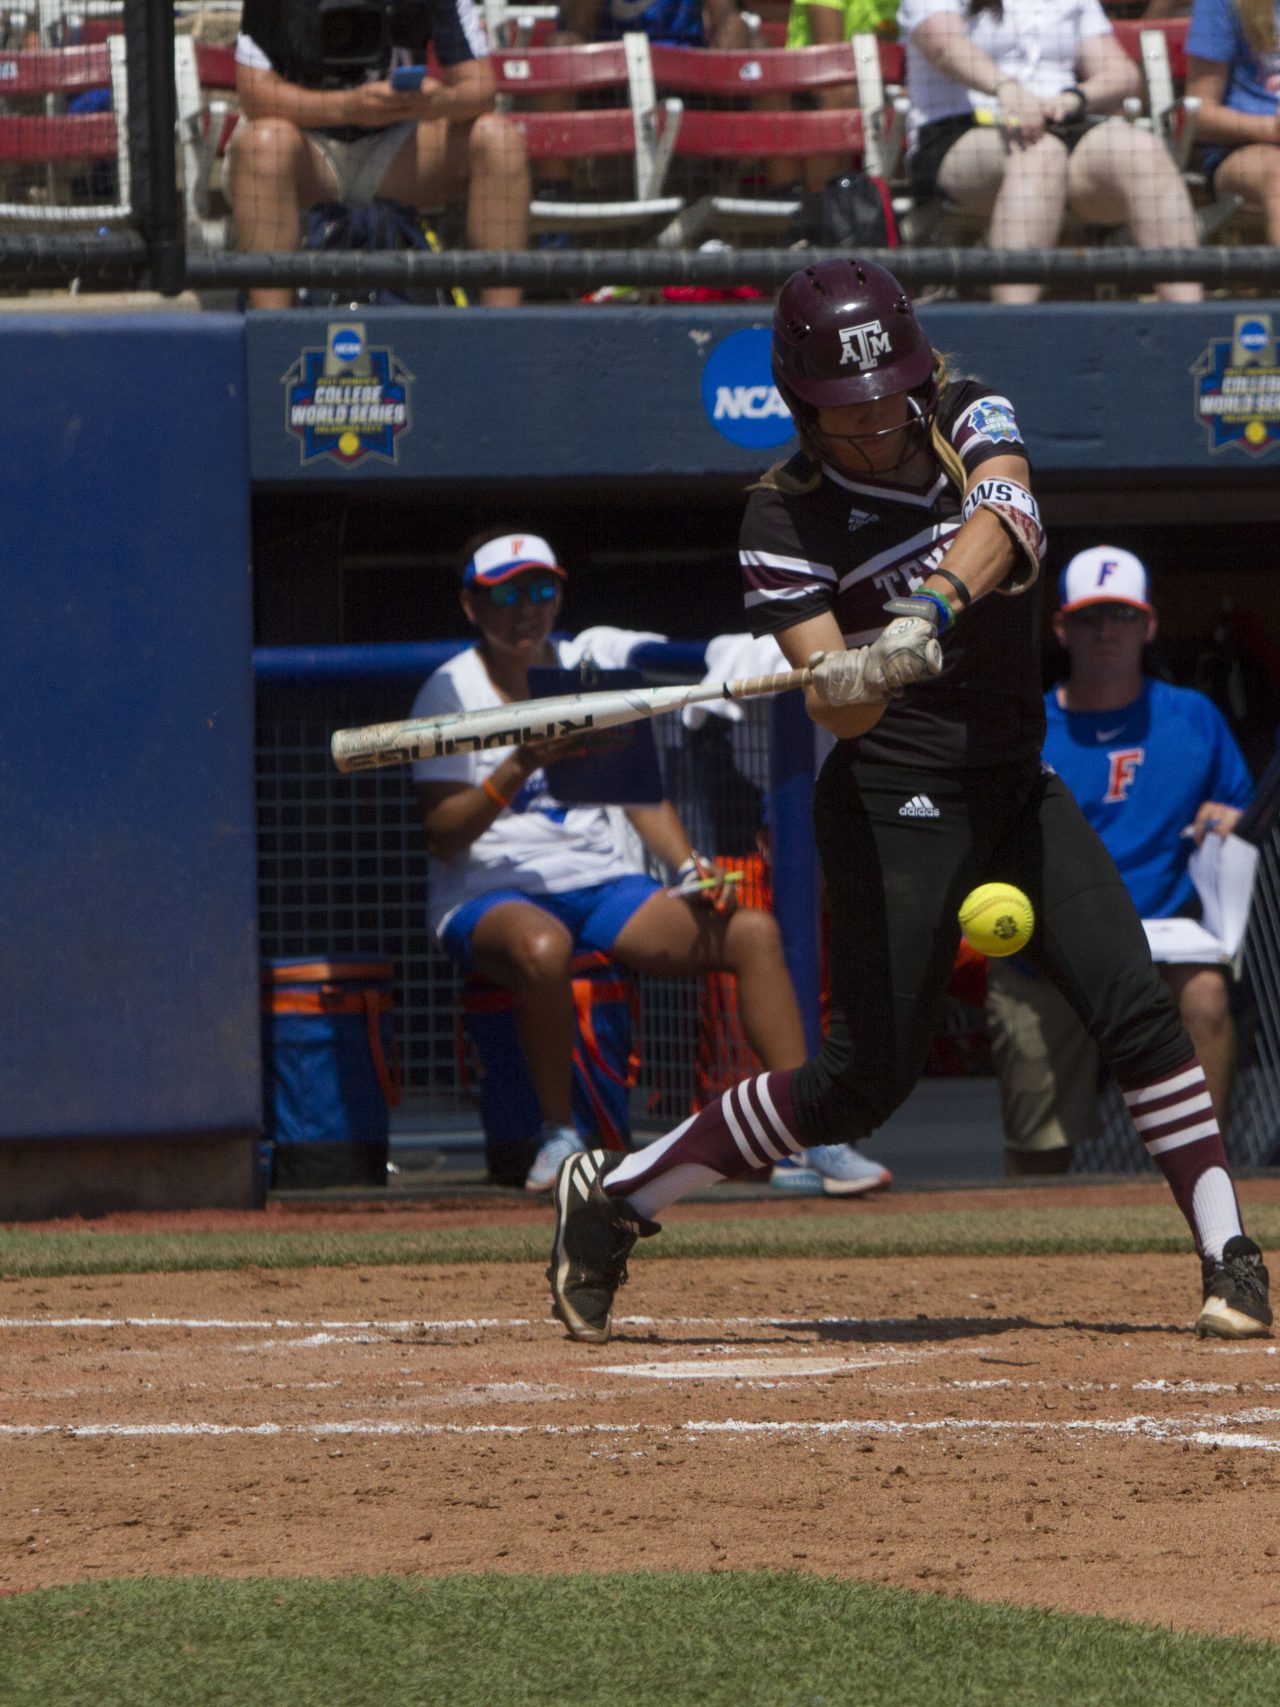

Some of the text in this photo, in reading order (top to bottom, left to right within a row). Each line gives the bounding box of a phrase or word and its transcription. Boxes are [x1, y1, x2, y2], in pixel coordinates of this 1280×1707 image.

[314, 385, 384, 404] COLLEGE
[713, 385, 792, 419] NCA
[291, 403, 406, 425] WORLD SERIES
[1095, 561, 1119, 586] F
[1102, 748, 1146, 804] F
[899, 807, 940, 817] adidas
